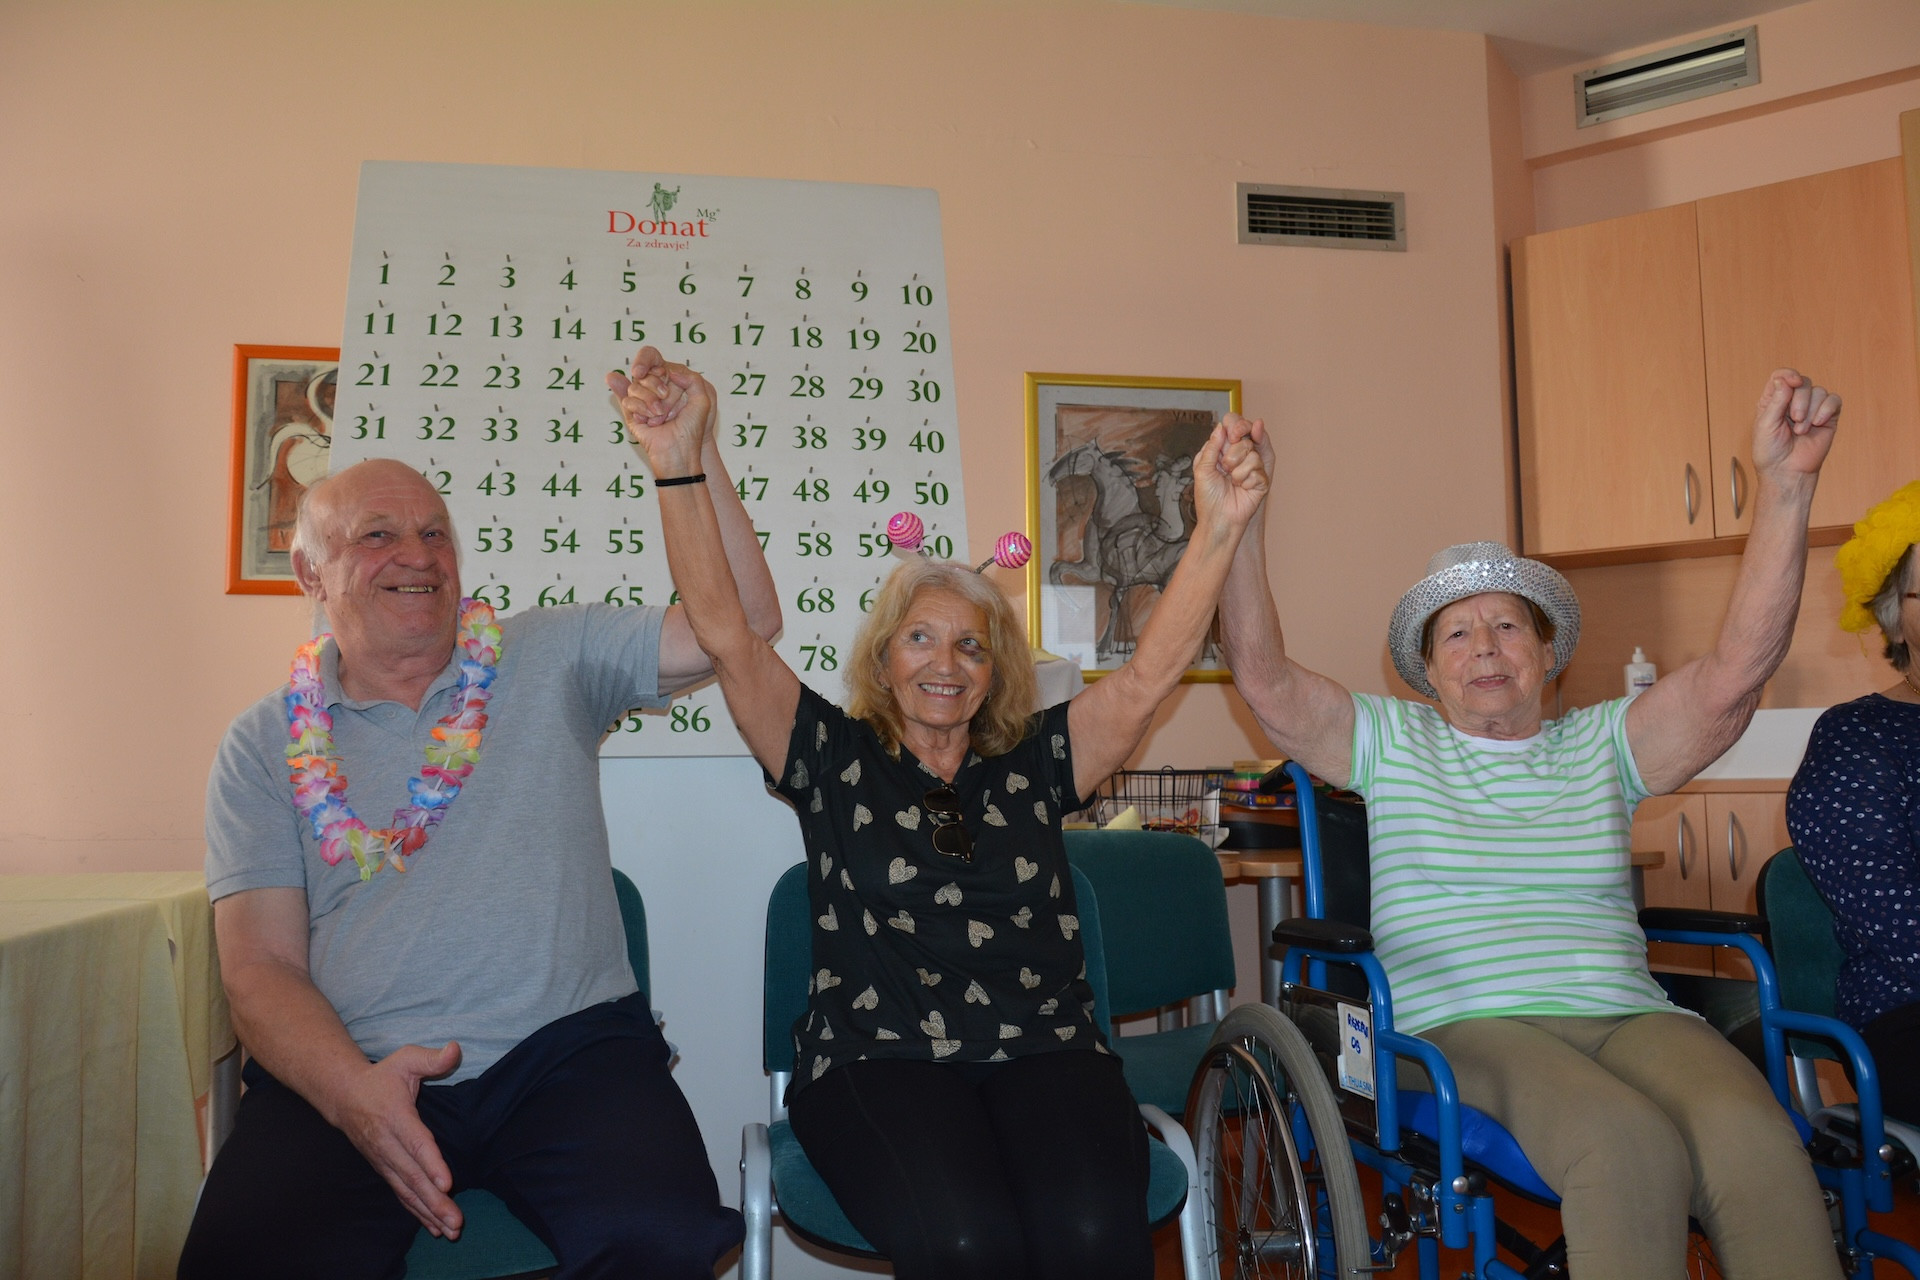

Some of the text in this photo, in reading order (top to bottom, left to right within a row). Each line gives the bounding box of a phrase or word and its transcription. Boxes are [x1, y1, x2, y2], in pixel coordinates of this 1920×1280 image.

[606, 210, 710, 237] Donat
[626, 238, 690, 251] Za zdravje!
[379, 263, 933, 306] 1 2 3 4 5 6 7 8 9 10
[364, 312, 936, 354] 11 12 13 14 15 16 17 18 19 20
[355, 363, 390, 386] 21
[419, 364, 459, 387] 22
[483, 366, 520, 389] 23
[546, 367, 585, 391] 24
[730, 373, 766, 396] 27
[789, 375, 825, 398] 28
[848, 377, 883, 400] 29
[907, 380, 940, 403] 30
[350, 416, 944, 453] 31 32 33 34 3 37 38 39 40
[476, 472, 516, 496] 43
[541, 473, 582, 497] 44
[605, 474, 644, 498] 45
[735, 477, 769, 501] 47
[792, 478, 830, 502] 48
[853, 480, 890, 503] 49
[914, 482, 949, 505] 50
[474, 527, 513, 553] 53
[540, 528, 581, 553] 54
[606, 529, 644, 554] 55
[795, 532, 832, 557] 58
[857, 534, 893, 557] 59
[538, 585, 579, 608] 64
[604, 586, 643, 608] 65
[797, 588, 835, 613] 68
[859, 588, 875, 613] 6
[799, 645, 837, 671] 78
[670, 705, 711, 732] 86
